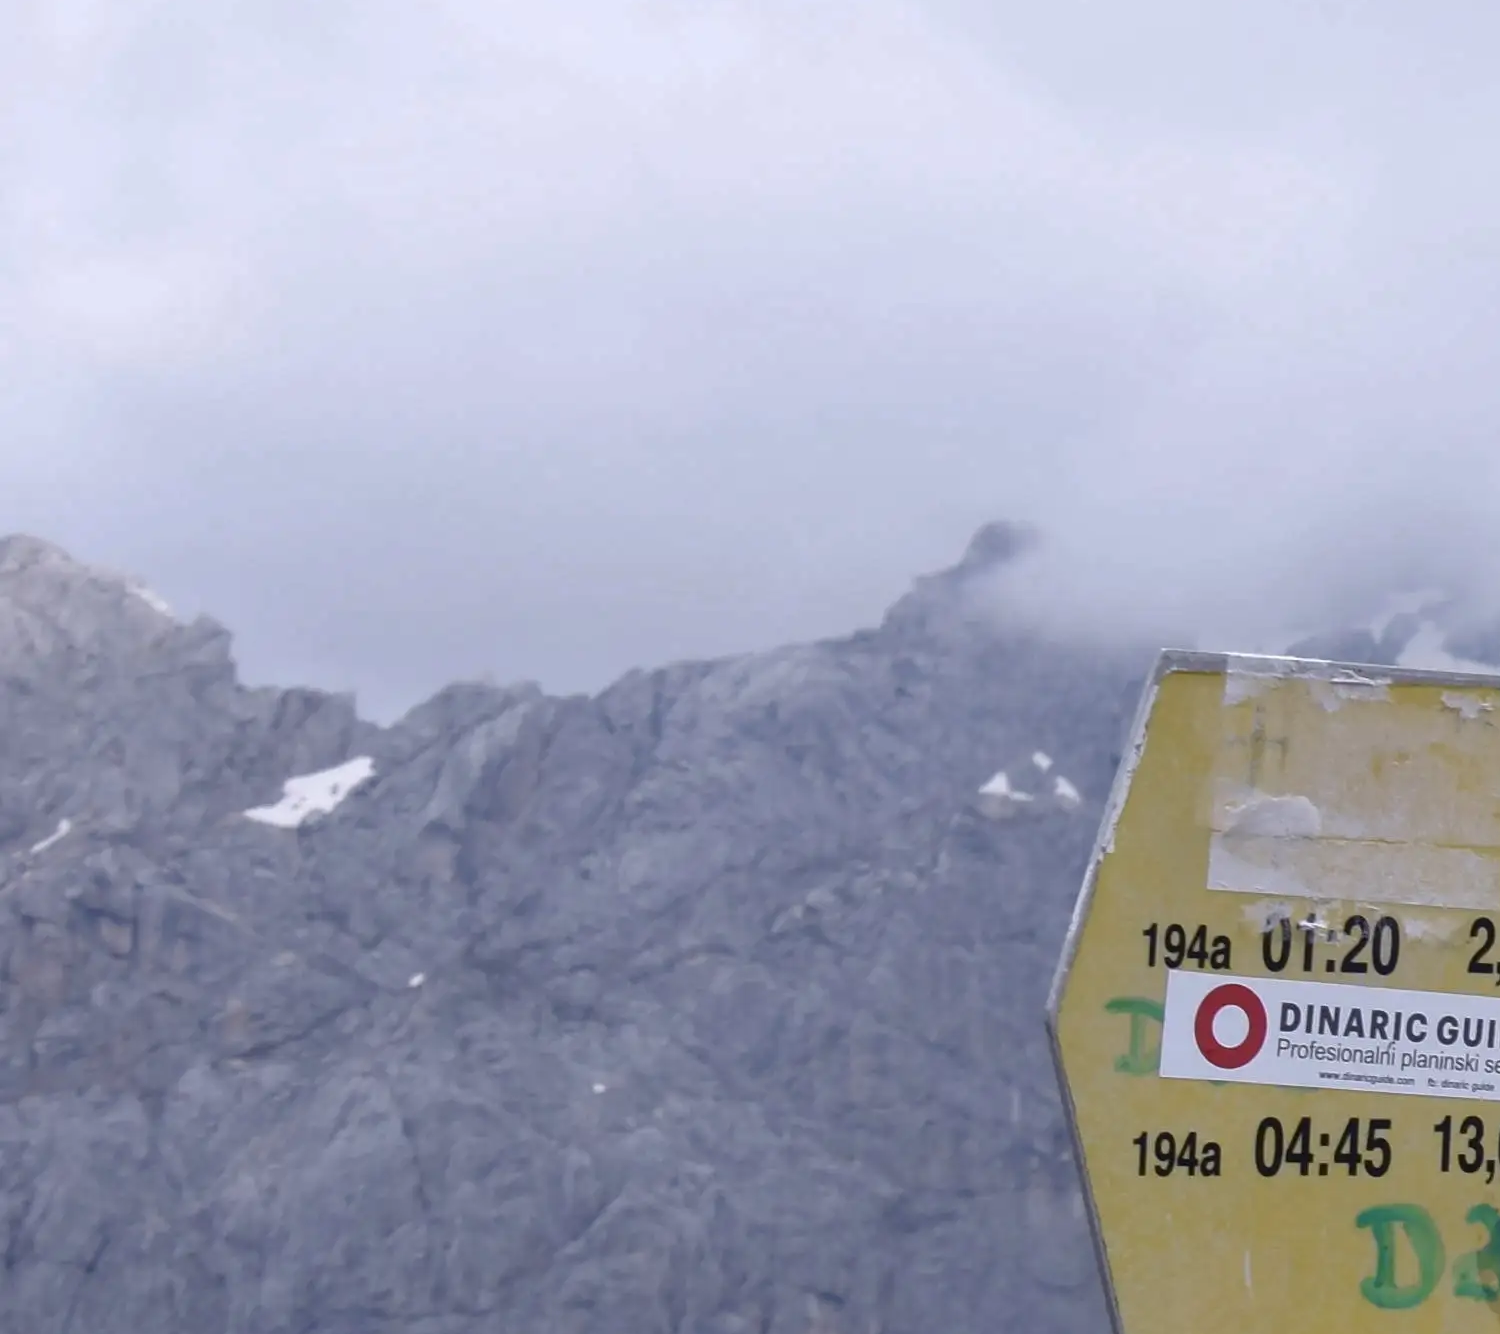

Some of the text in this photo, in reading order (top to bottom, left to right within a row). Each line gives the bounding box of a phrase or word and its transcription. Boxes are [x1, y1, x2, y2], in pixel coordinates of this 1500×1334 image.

[1141, 921, 1232, 969] 194a
[1262, 914, 1401, 976] 01:20
[1279, 1001, 1428, 1043] DINARIC
[1276, 1037, 1397, 1067] Profesionalni
[1400, 1049, 1480, 1073] planinski
[1132, 1131, 1223, 1178] 194a
[1254, 1116, 1392, 1178] 04:45
